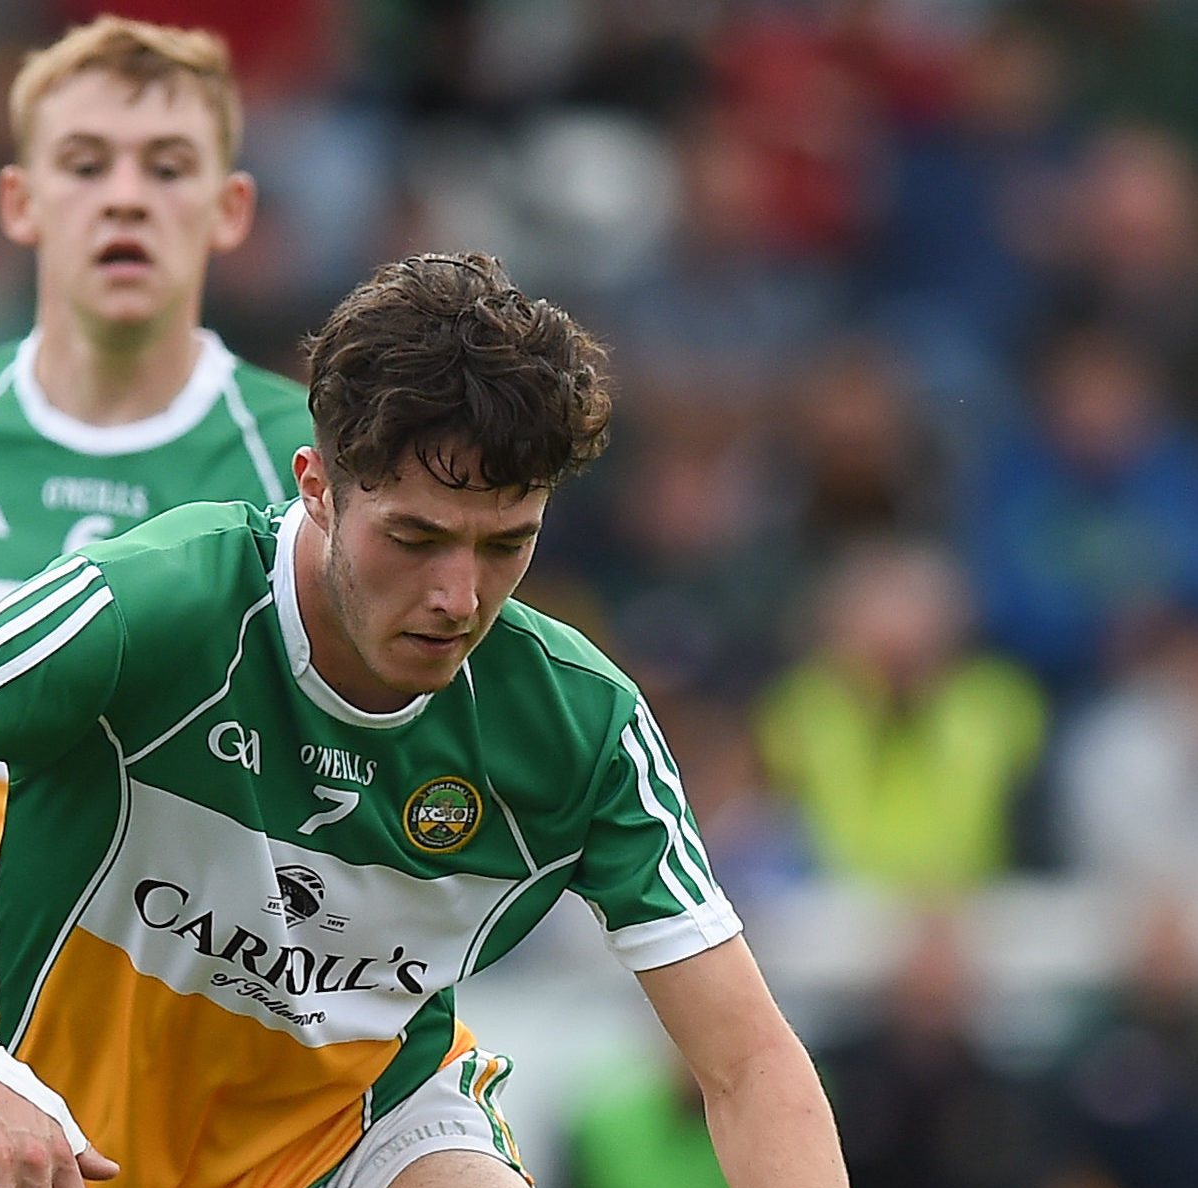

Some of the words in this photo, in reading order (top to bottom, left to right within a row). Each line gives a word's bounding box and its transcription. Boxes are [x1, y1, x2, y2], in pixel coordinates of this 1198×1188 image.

[301, 744, 378, 786] O'NEILLS
[297, 784, 360, 836] 7
[210, 970, 248, 987] of
